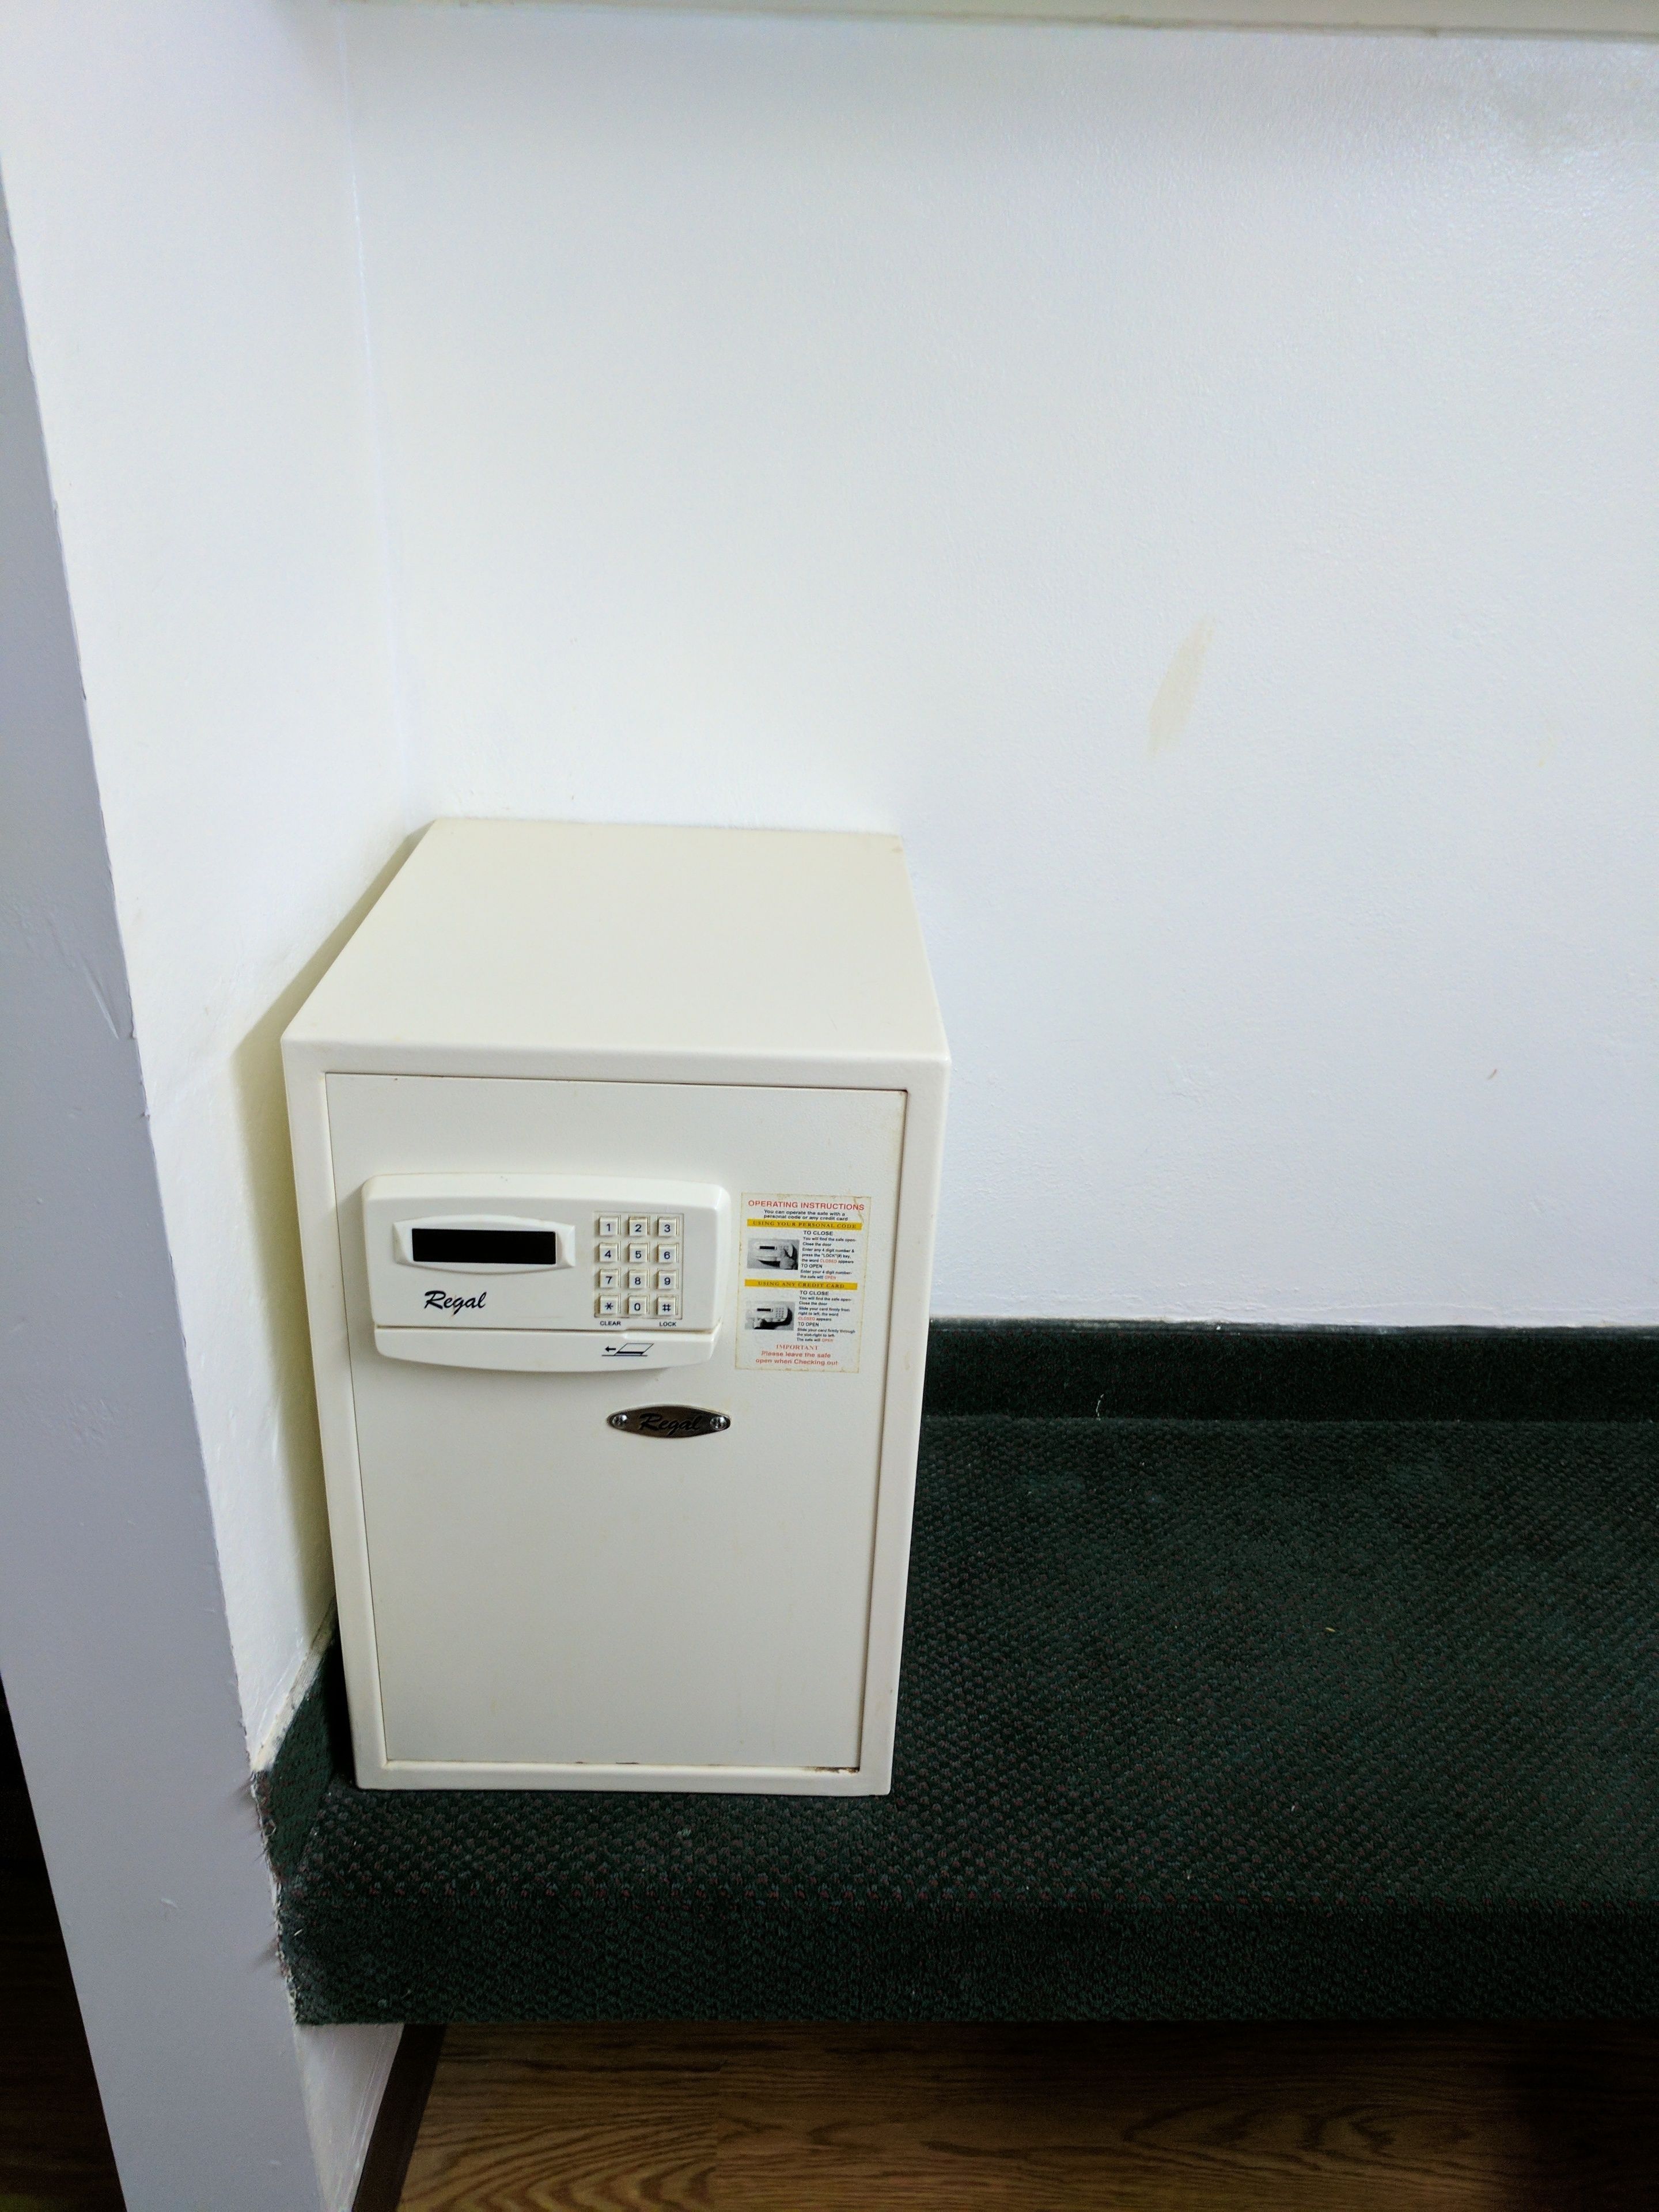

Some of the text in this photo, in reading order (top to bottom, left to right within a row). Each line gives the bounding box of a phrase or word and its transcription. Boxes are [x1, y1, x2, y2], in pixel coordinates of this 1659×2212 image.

[605, 1250, 611, 1258] 4
[635, 1251, 641, 1259] 5
[424, 1290, 487, 1315] Regal
[639, 1413, 703, 1436] Regal
